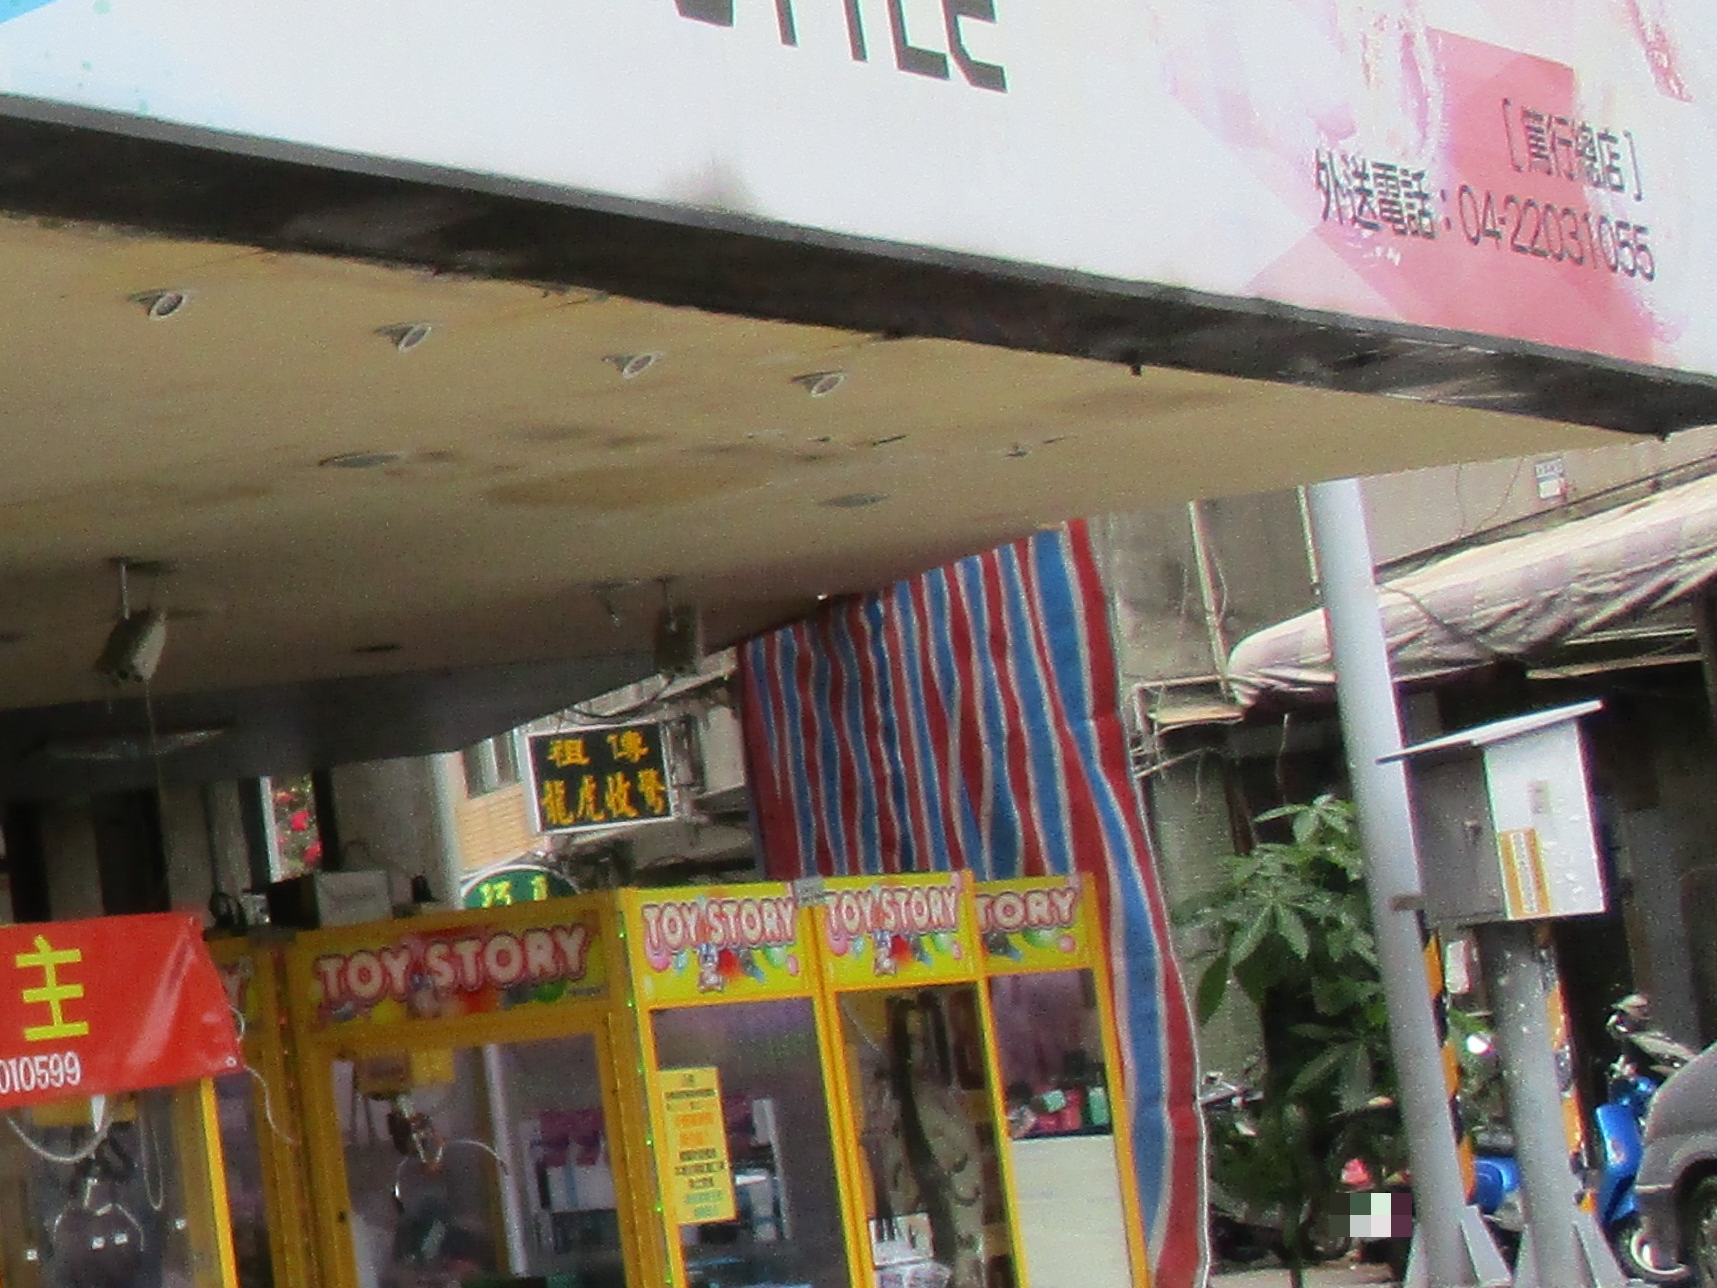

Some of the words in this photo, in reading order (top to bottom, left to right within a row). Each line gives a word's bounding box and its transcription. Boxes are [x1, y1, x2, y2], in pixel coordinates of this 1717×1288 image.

[546, 729, 649, 769] 祖傳
[641, 900, 702, 955] TOY
[703, 898, 798, 950] STORY
[825, 890, 880, 938] TOY
[879, 885, 962, 938] STORY
[976, 887, 1080, 934] TORY
[313, 944, 415, 1004] TOY
[420, 924, 591, 993] STORY
